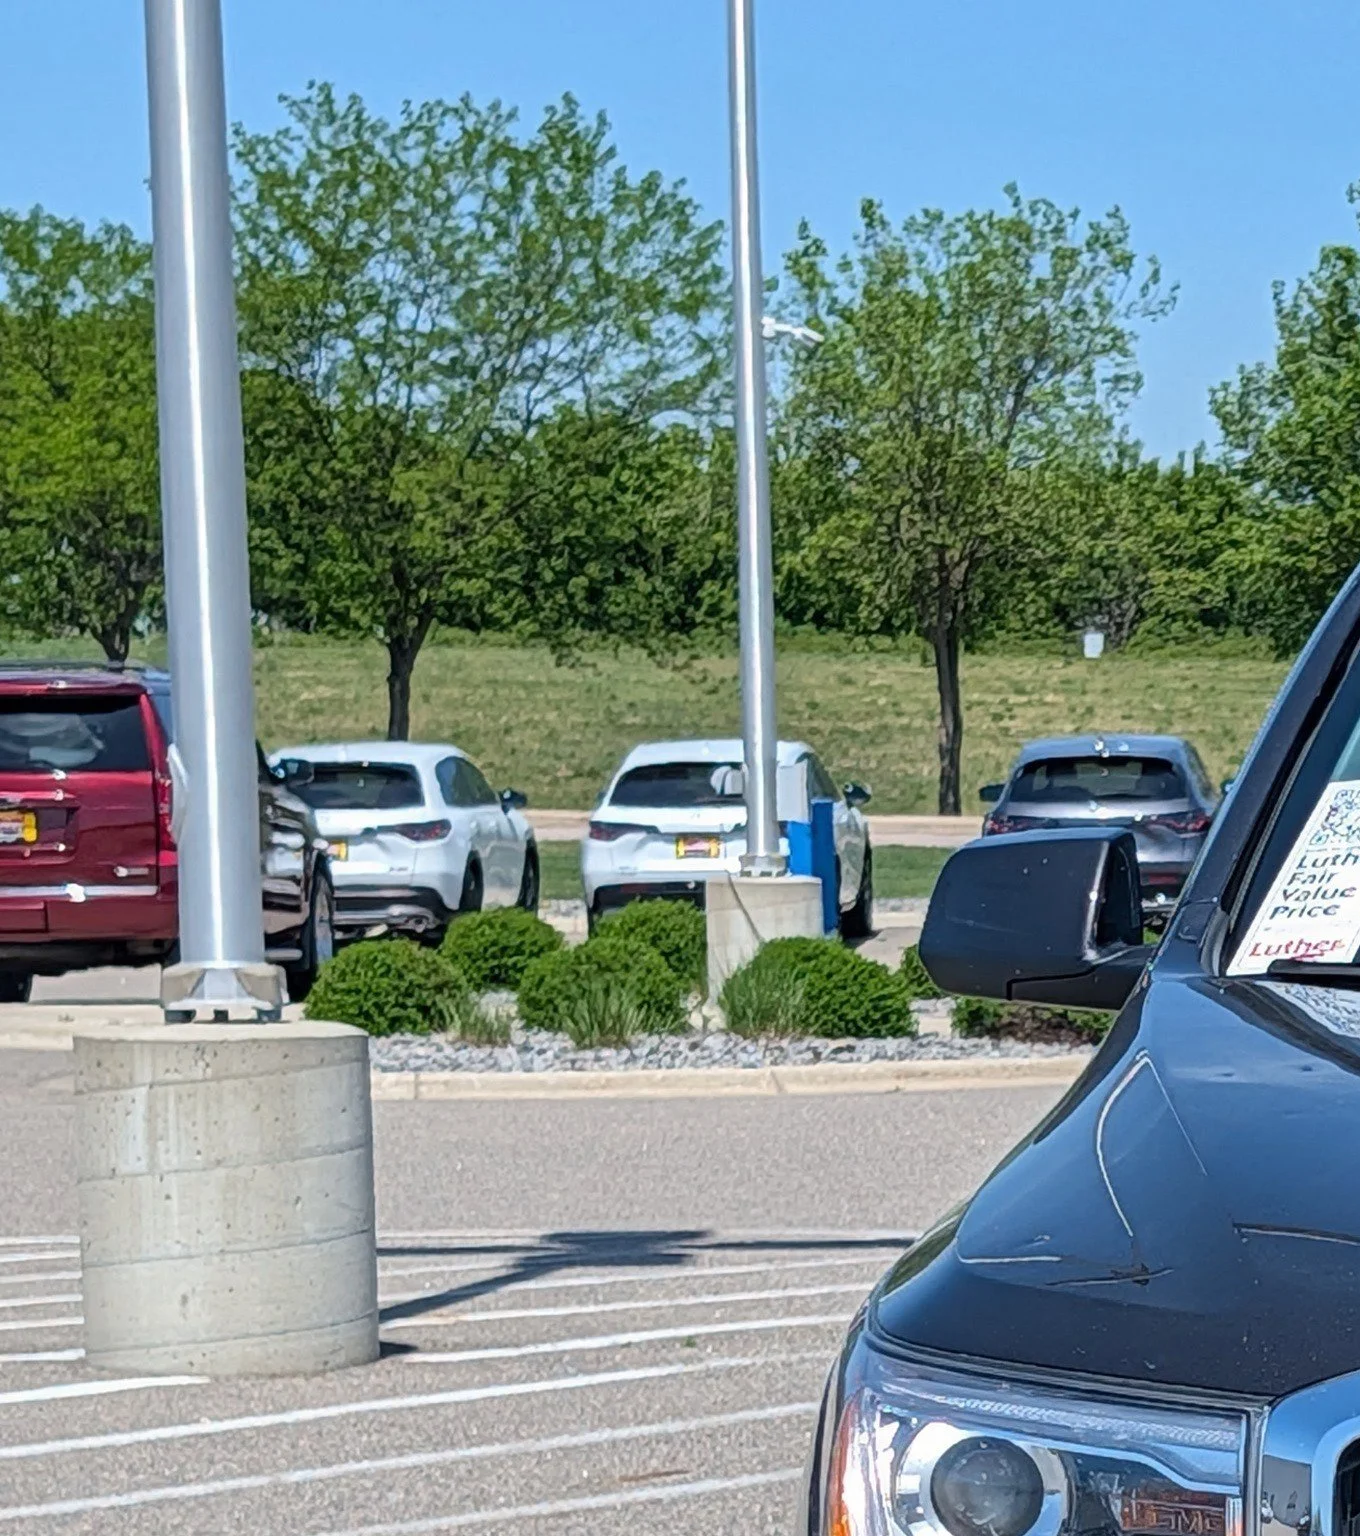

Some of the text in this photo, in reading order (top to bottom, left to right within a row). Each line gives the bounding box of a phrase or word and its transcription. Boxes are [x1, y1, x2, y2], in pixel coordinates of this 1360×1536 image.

[1287, 870, 1338, 886] Fair
[1282, 886, 1357, 902] Value
[1269, 904, 1341, 920] Price
